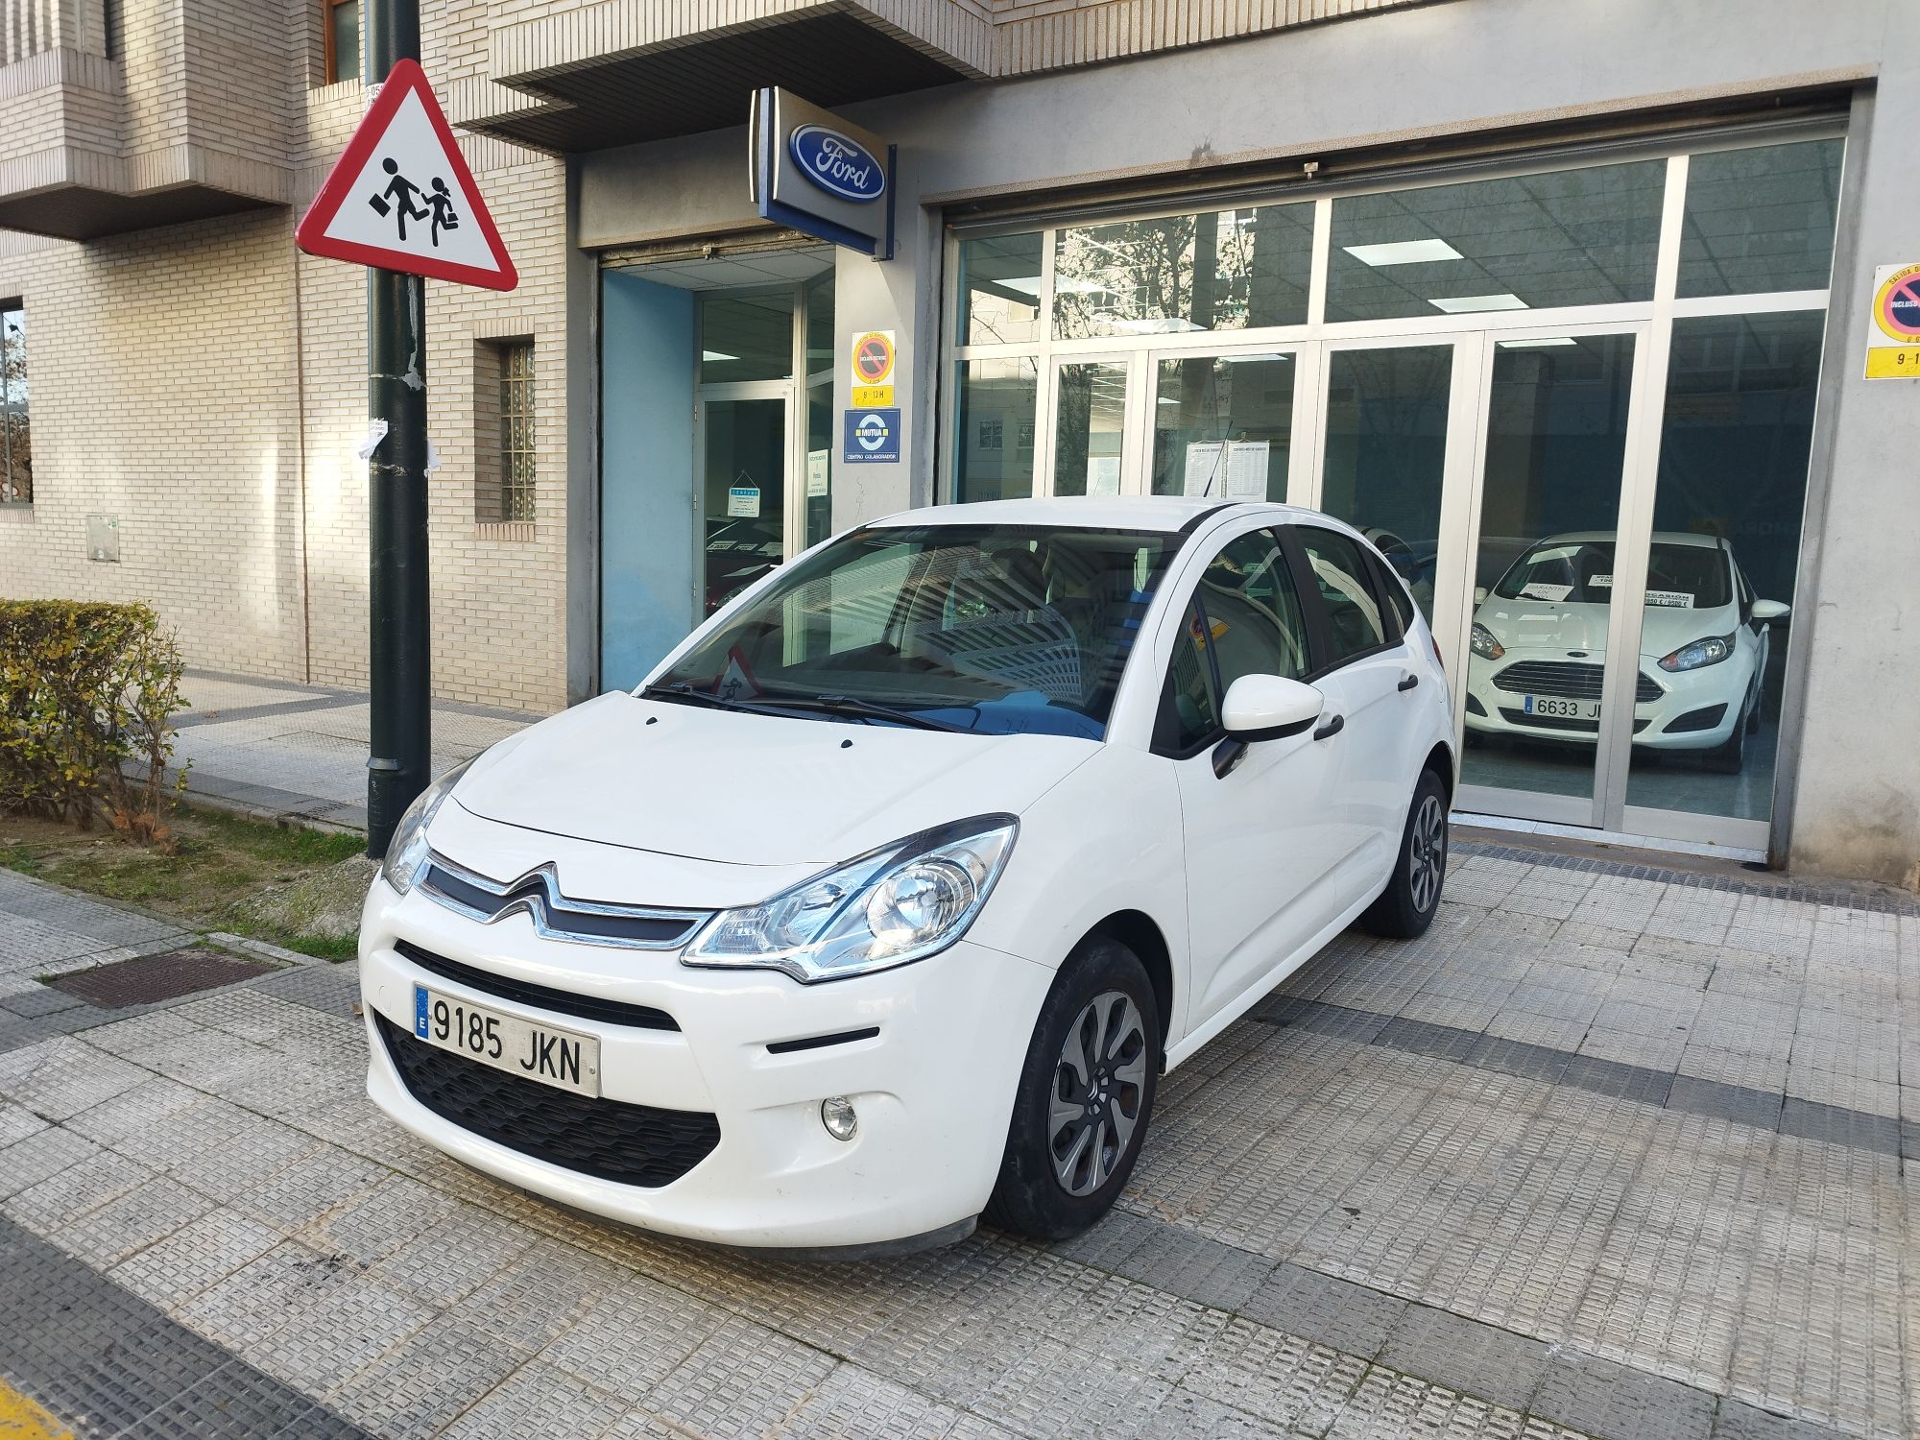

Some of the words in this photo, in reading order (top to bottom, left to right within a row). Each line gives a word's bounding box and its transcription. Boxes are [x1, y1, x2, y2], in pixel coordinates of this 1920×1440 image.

[814, 136, 870, 190] Ford
[1889, 269, 1912, 285] SALIDA
[861, 428, 882, 437] MUTUA
[1537, 699, 1578, 716] 6633
[434, 1000, 502, 1059] 9185
[520, 1029, 580, 1085] JKN
